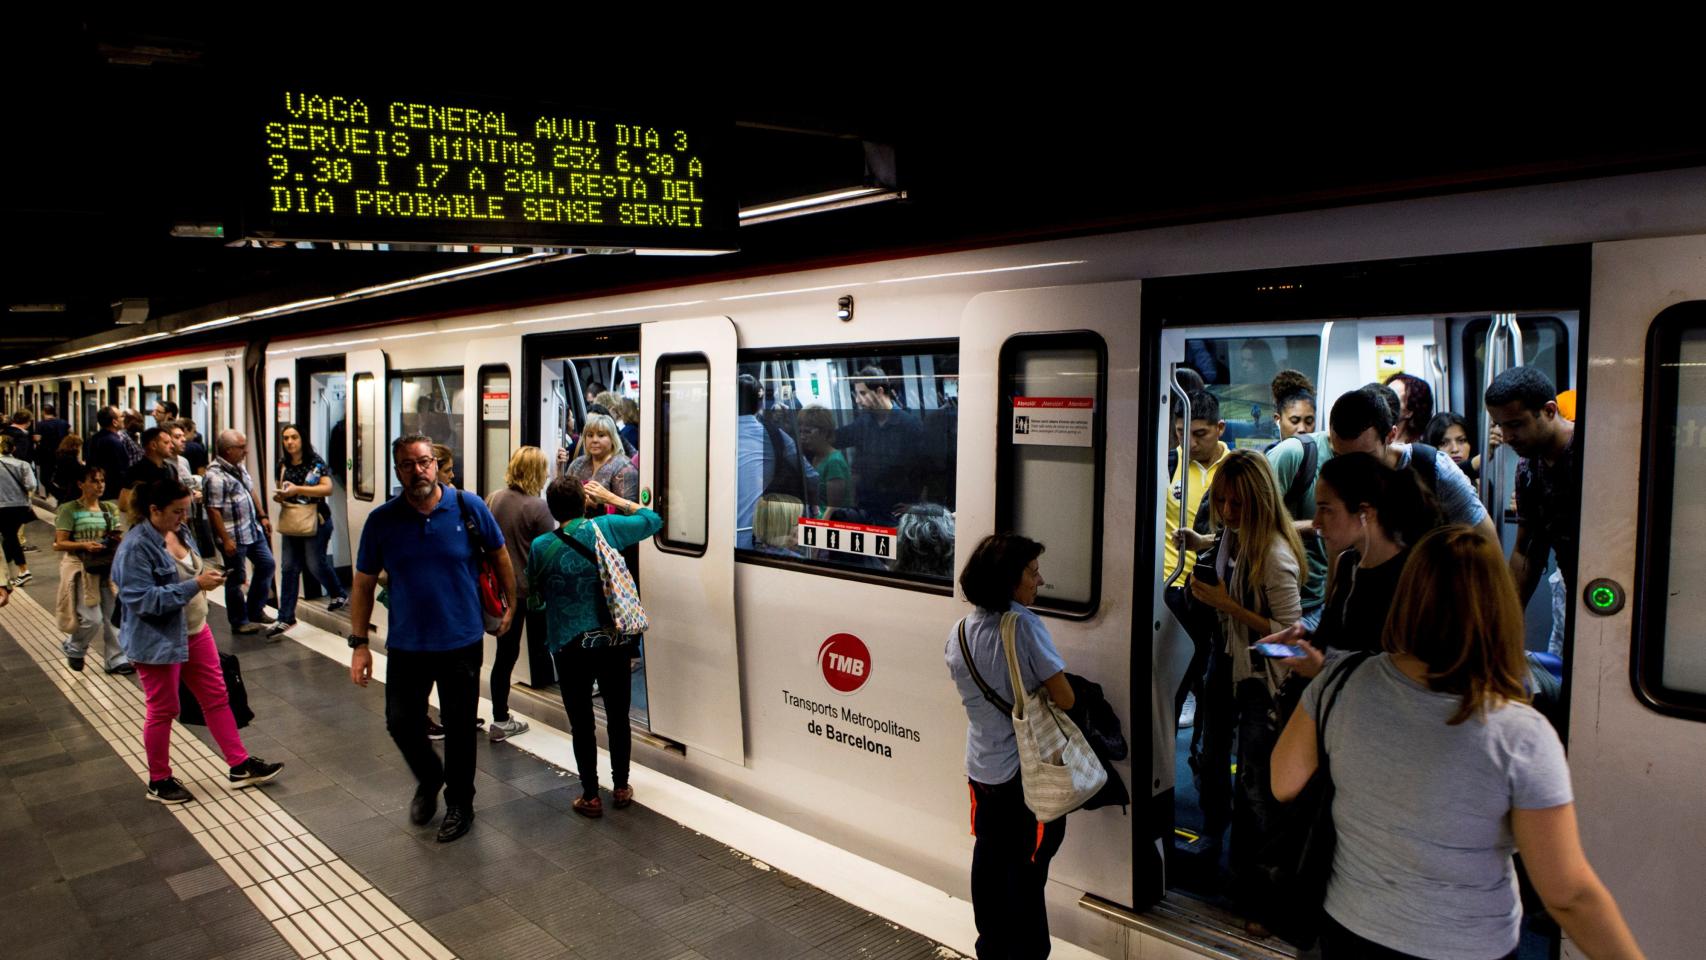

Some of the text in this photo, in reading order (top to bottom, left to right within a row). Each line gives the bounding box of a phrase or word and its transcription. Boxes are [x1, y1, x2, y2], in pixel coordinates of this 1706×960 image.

[286, 92, 687, 151] VAGA GENERAL AVUI DIA 3
[266, 122, 409, 156] SERVEIS
[553, 145, 600, 170] 25%
[617, 150, 674, 175] 6.30
[689, 156, 702, 177] A
[267, 154, 352, 183] 9.30
[377, 161, 389, 185] I
[416, 163, 448, 187] 17
[469, 167, 485, 190] A
[662, 179, 703, 202] DEL
[271, 186, 702, 227] DIA PROBABLE SENSE SERVEI
[829, 652, 865, 677] TMB
[782, 690, 921, 743] Transports Metropolitans
[807, 720, 892, 758] de Barcelona
